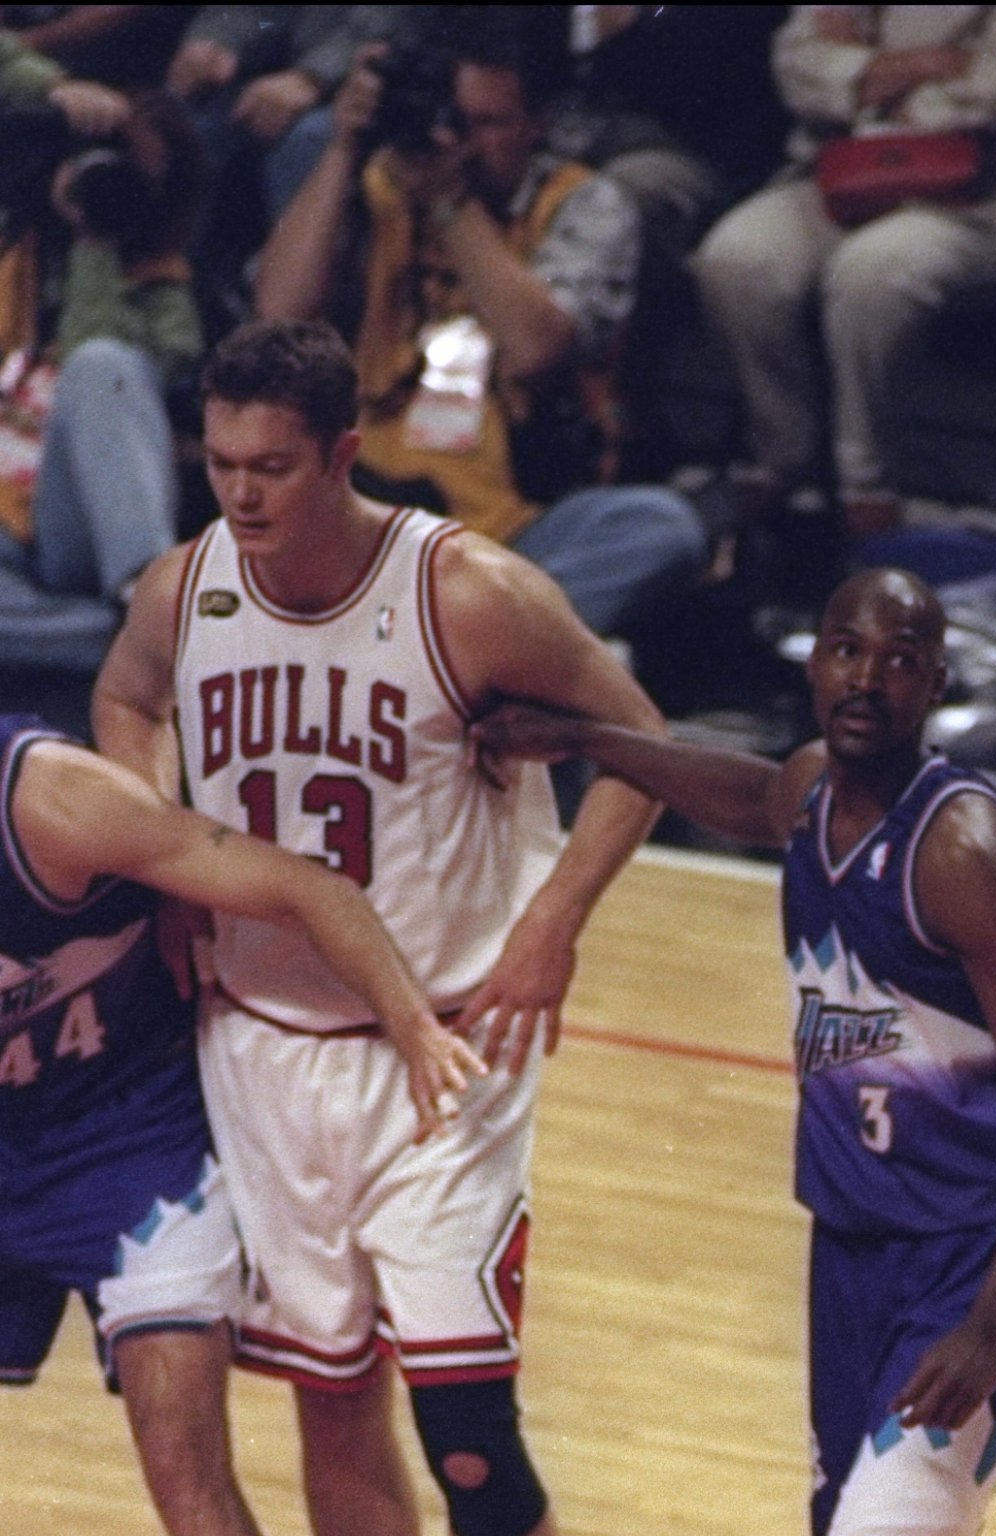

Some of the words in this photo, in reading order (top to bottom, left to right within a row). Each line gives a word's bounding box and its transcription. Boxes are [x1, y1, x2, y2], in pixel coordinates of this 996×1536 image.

[200, 662, 408, 785] BULLS
[238, 767, 374, 890] 13
[0, 990, 106, 1088] 44
[859, 1084, 893, 1154] 3
